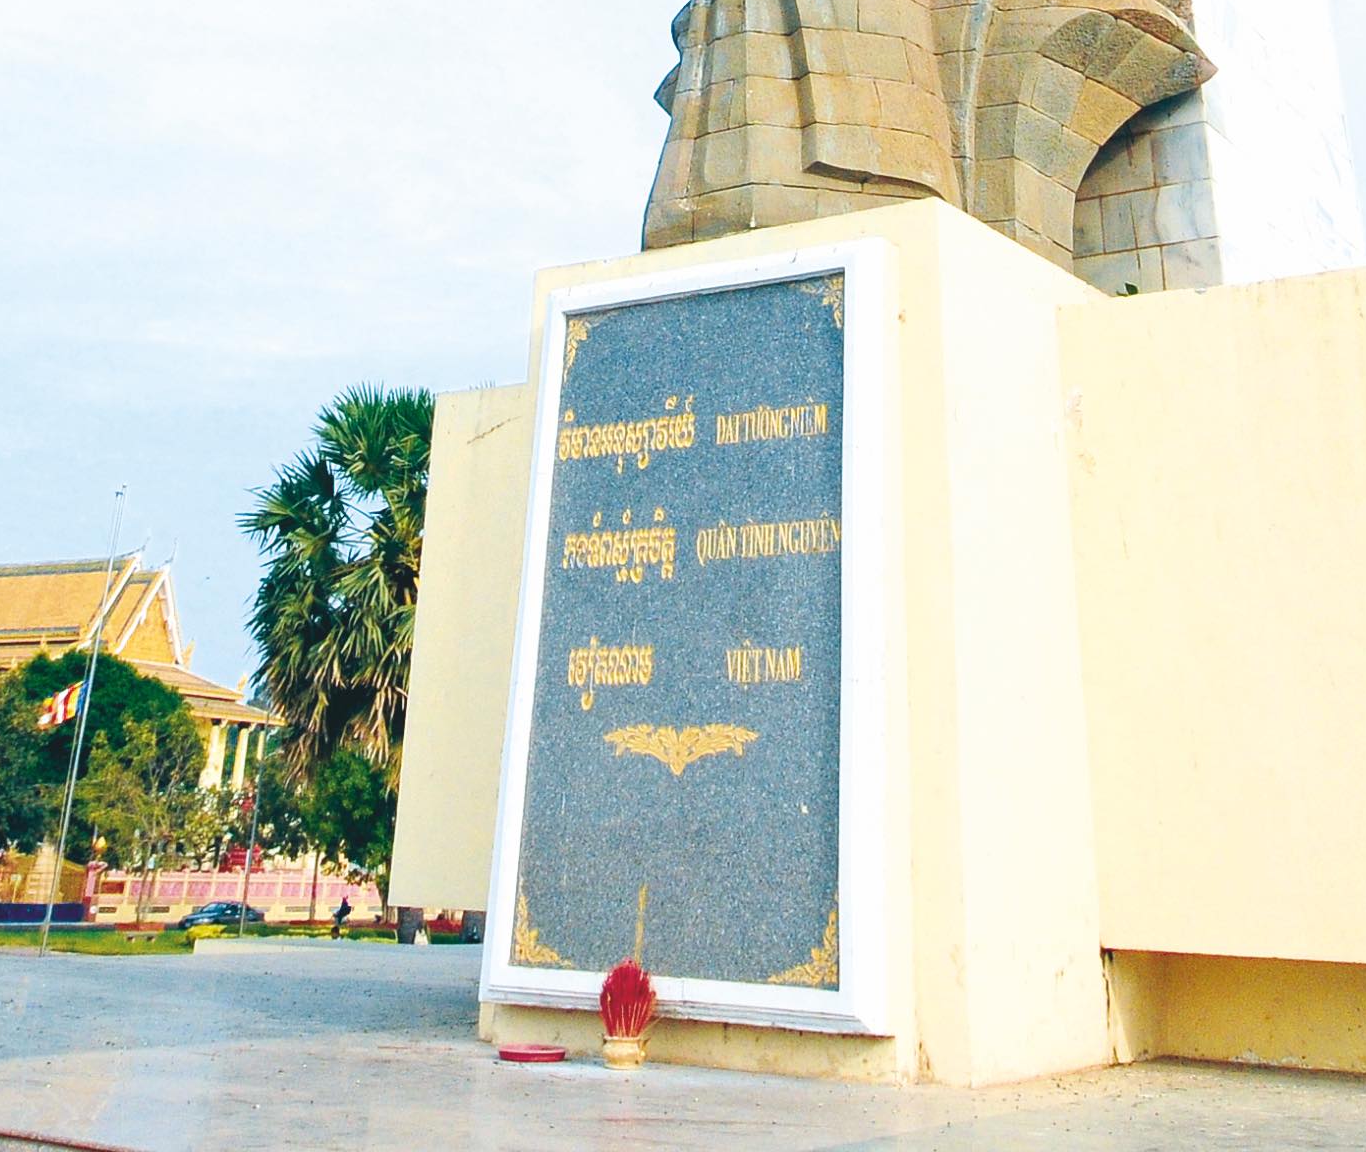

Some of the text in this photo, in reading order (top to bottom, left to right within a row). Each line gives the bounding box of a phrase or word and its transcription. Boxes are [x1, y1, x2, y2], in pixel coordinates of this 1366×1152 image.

[696, 518, 737, 567] QUÂN
[739, 518, 775, 559] TÌNH
[725, 638, 802, 691] VIỆT NAM
